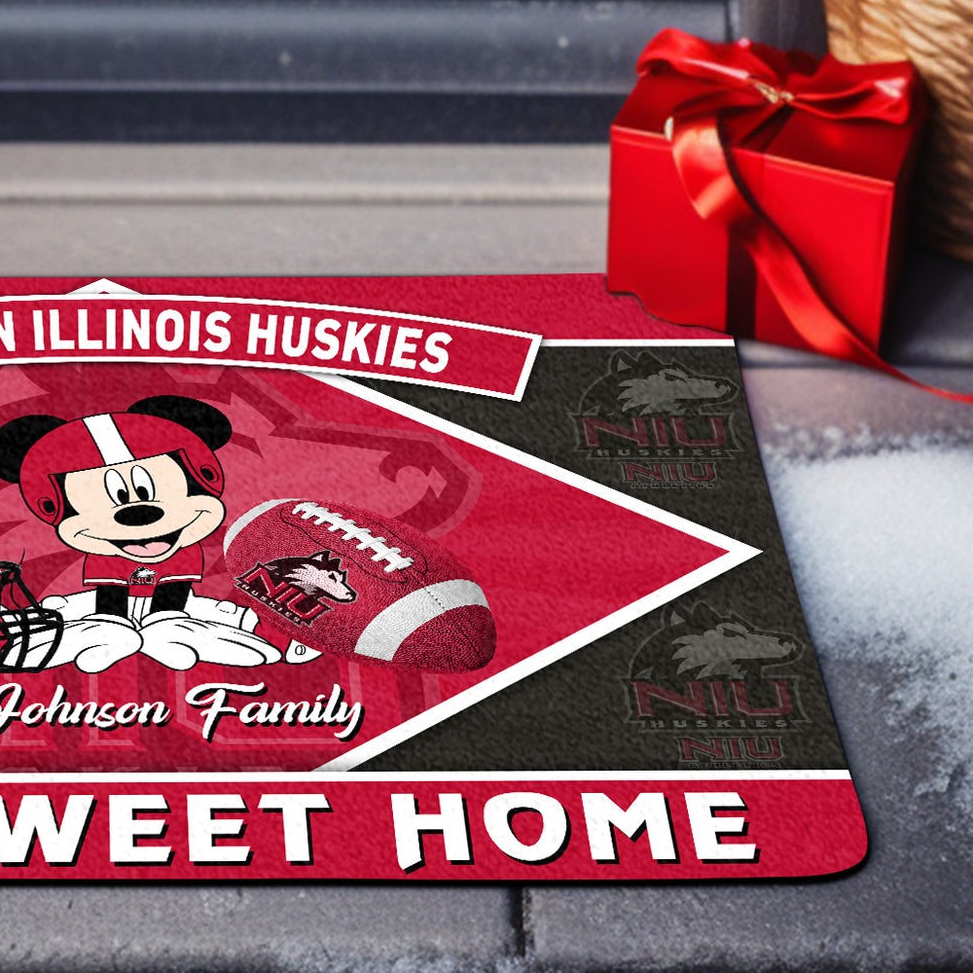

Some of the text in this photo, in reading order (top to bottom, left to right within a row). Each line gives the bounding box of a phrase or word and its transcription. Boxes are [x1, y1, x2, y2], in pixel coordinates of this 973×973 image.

[32, 309, 232, 351] ILLINOIS
[245, 312, 453, 374] HUSKIES
[580, 417, 727, 448] NIU
[595, 449, 723, 457] HUSKIES
[620, 462, 718, 483] NIU
[240, 583, 302, 624] HUSKIES
[244, 567, 327, 619] NIU
[185, 681, 364, 743] Family
[630, 681, 795, 718] NIU
[650, 719, 788, 728] HUSKIES
[674, 736, 785, 762] NIU
[390, 791, 760, 874] HOME
